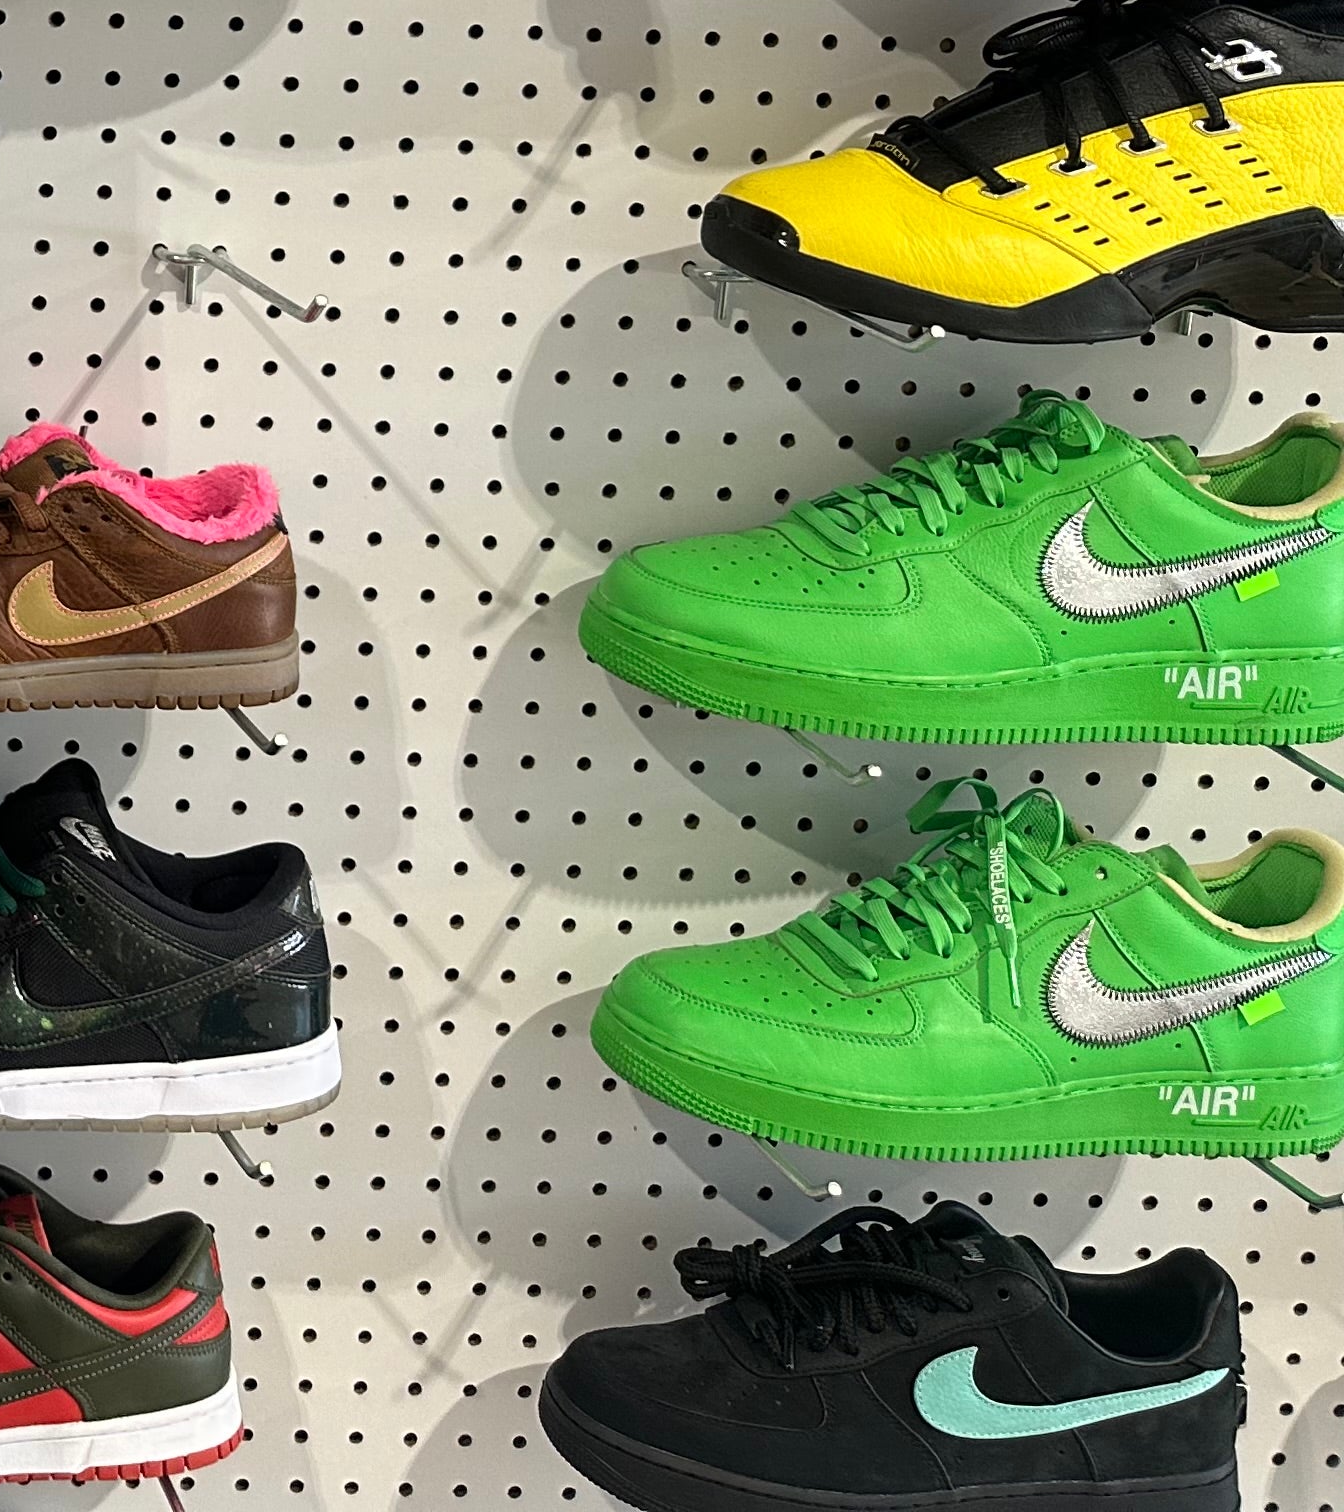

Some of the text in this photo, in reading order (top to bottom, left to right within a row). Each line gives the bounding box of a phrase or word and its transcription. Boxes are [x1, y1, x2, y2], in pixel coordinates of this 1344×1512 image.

[1164, 664, 1258, 700] "AIR"
[1263, 686, 1311, 715] AIR
[989, 840, 1012, 930] "SHOELACES"
[1158, 1085, 1255, 1117] "AIR"
[1260, 1104, 1309, 1131] AIR
